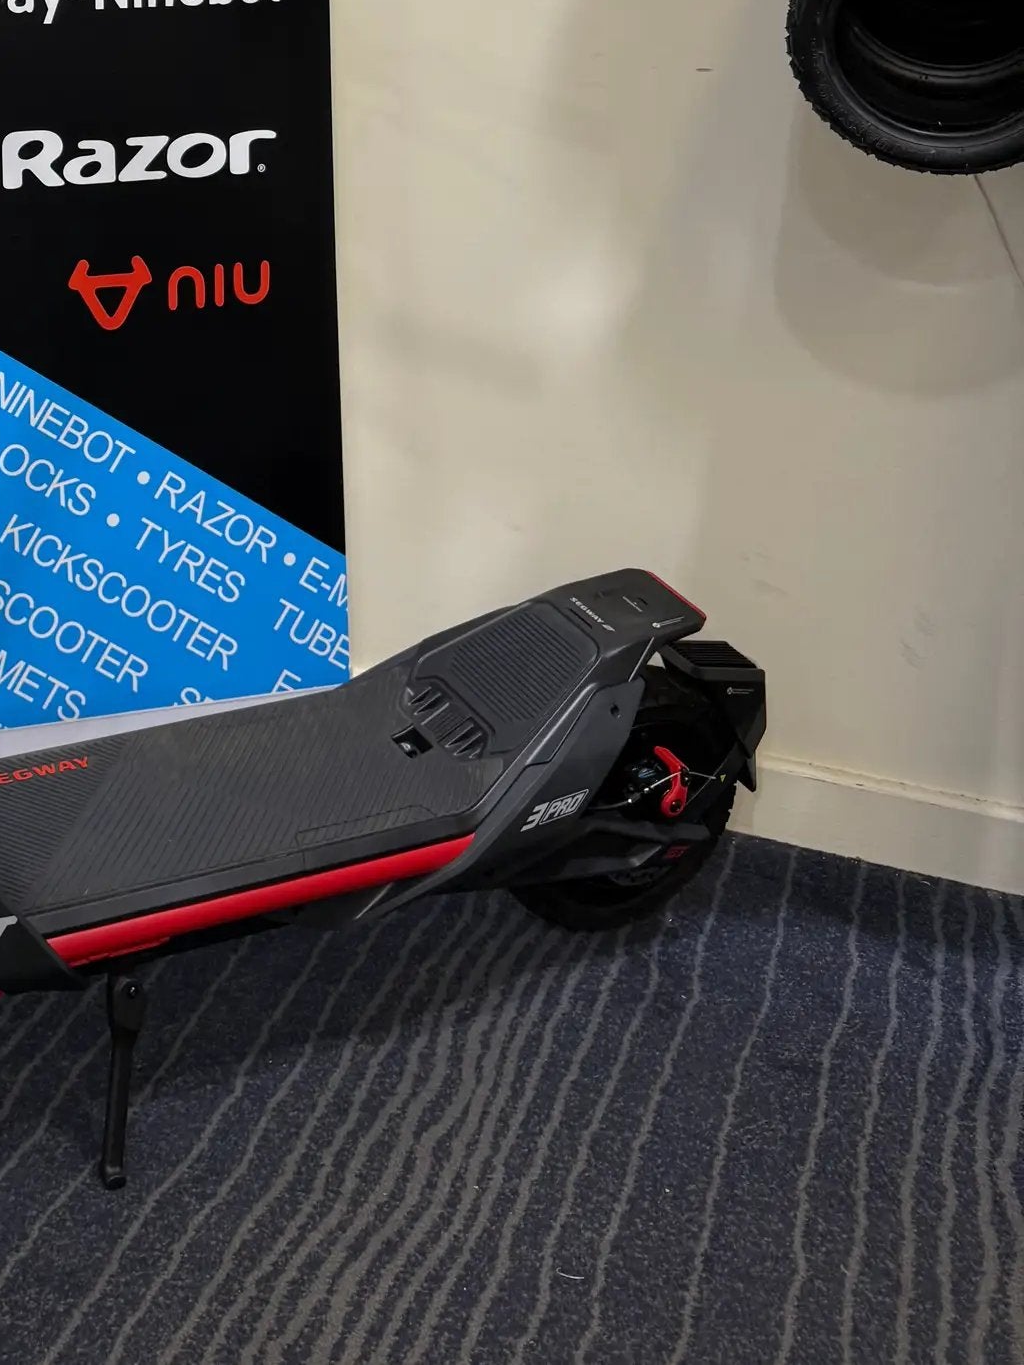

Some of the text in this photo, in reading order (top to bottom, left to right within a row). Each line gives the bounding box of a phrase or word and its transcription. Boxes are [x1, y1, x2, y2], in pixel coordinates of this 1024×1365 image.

[154, 470, 277, 564] RAZOR
[135, 517, 246, 602] TYRES
[569, 597, 605, 624] SEGWAY
[520, 792, 585, 832] 3 PRO
